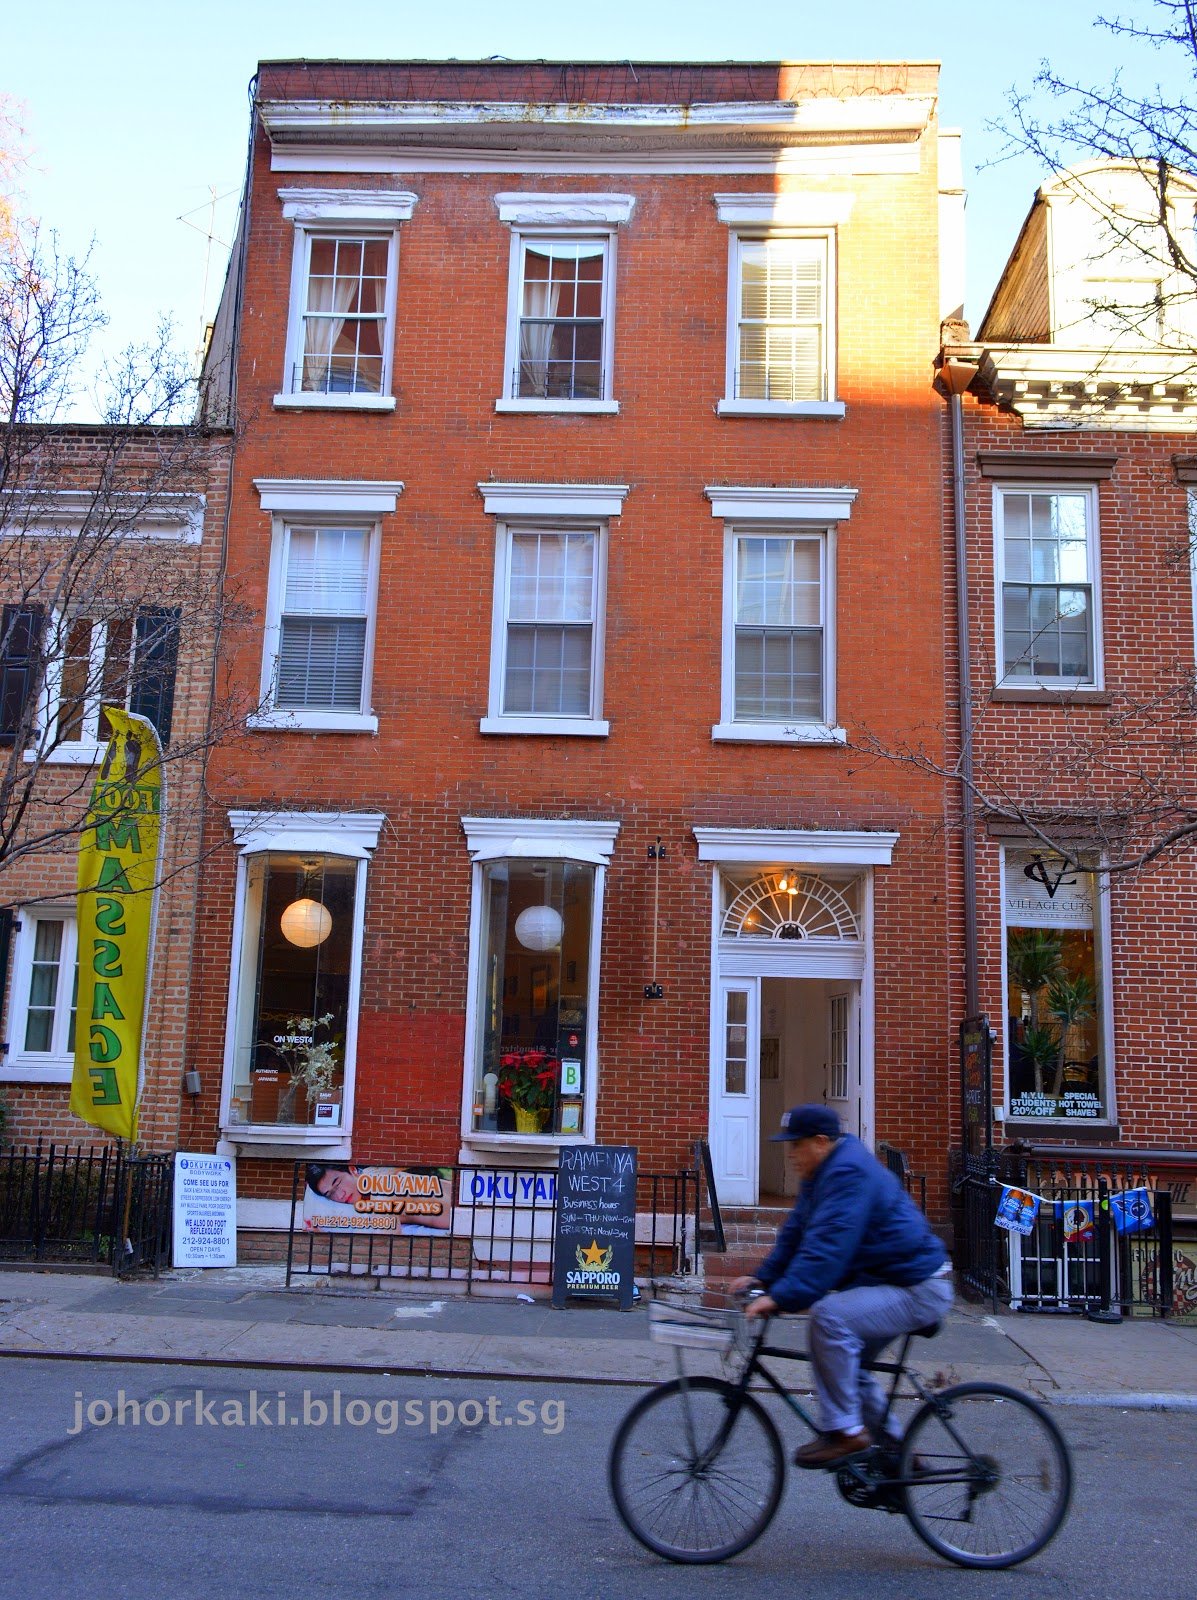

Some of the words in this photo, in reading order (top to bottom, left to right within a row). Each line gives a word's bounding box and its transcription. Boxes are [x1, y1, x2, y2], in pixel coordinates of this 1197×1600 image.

[1008, 899, 1058, 910] VILLAGE
[1062, 902, 1093, 912] CUTS
[273, 1034, 286, 1043] ON
[566, 1066, 576, 1085] B
[1064, 1092, 1098, 1100] SPECIAL
[1010, 1099, 1056, 1107] STUDENTS
[1066, 1108, 1097, 1117] SHAVES
[190, 1161, 222, 1170] OKUYAMA
[357, 1174, 442, 1196] OKUYAMA
[568, 1175, 612, 1192] WEST
[612, 1177, 626, 1192] 4
[1167, 1182, 1192, 1203] THE
[355, 1201, 393, 1213] OPEN
[394, 1202, 404, 1214] 7
[406, 1202, 442, 1214] DAYS
[562, 1196, 598, 1210] Business
[599, 1196, 620, 1209] hours
[312, 1216, 397, 1230] Tel:212-924-8801
[1012, 1225, 1026, 1233] FANS
[566, 1271, 621, 1284] SAPPORO
